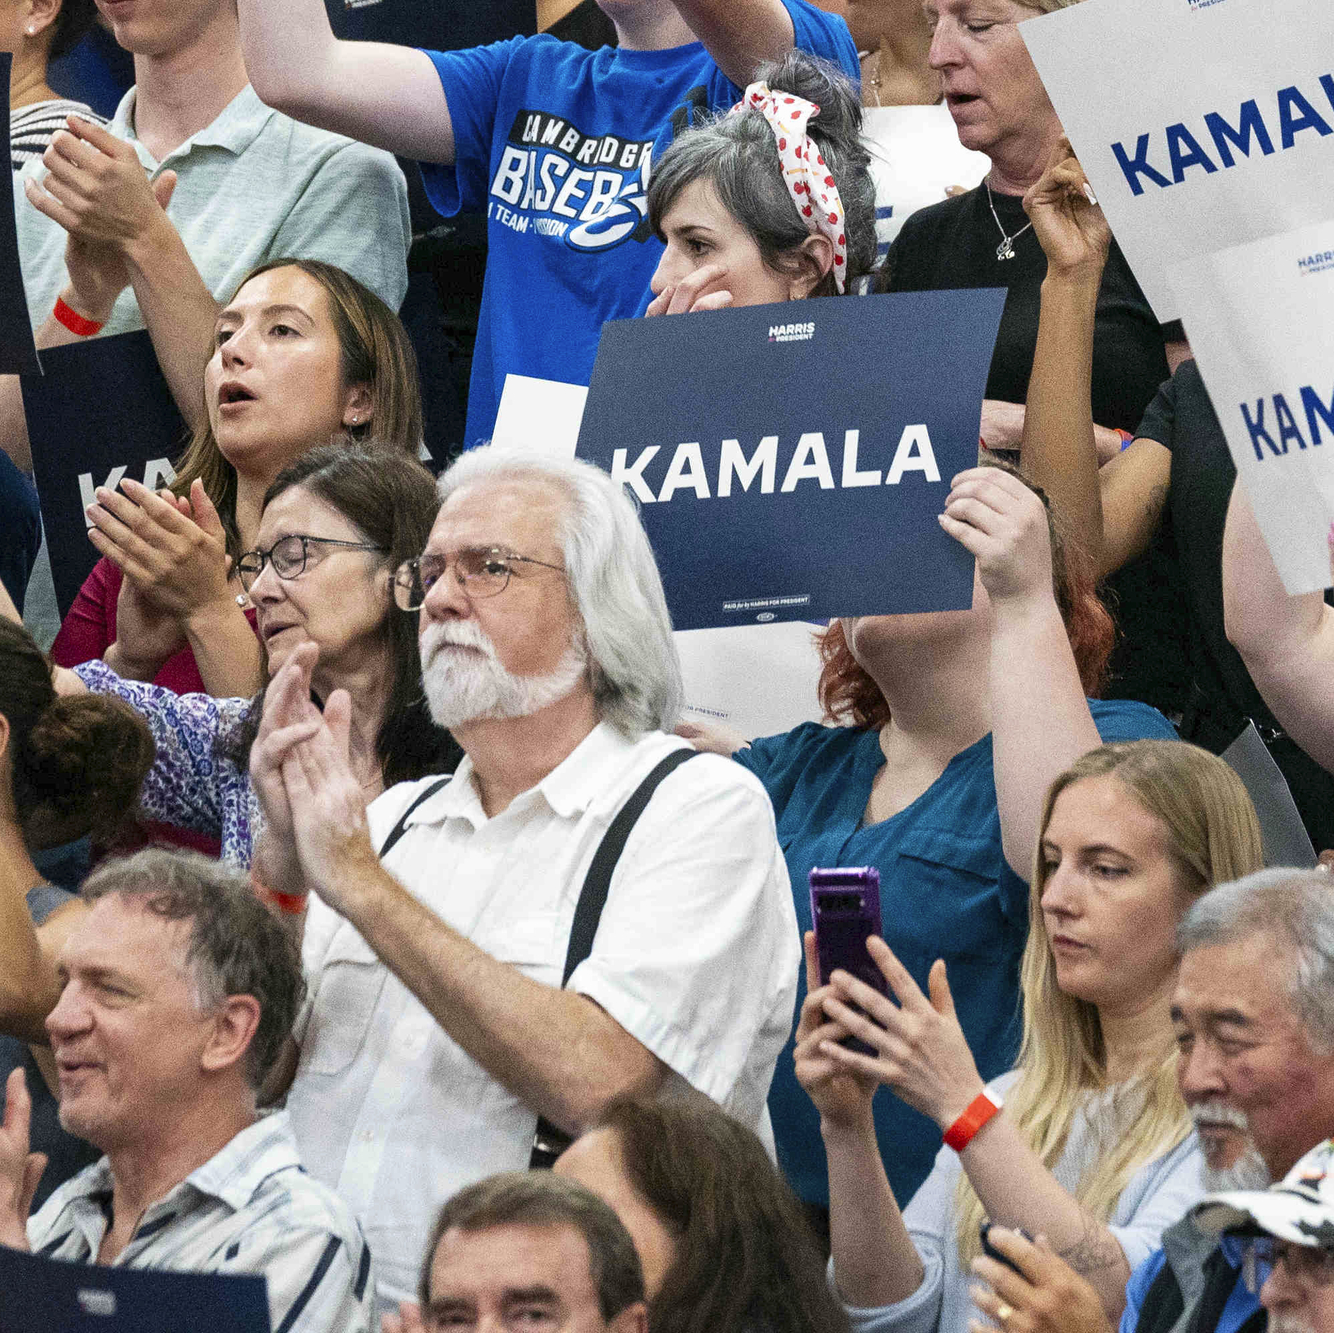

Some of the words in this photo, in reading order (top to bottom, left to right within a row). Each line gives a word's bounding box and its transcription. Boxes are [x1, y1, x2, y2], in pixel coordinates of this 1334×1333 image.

[496, 204, 529, 234] TEAM
[768, 322, 815, 337] HARRIS
[610, 424, 941, 504] KAMALA
